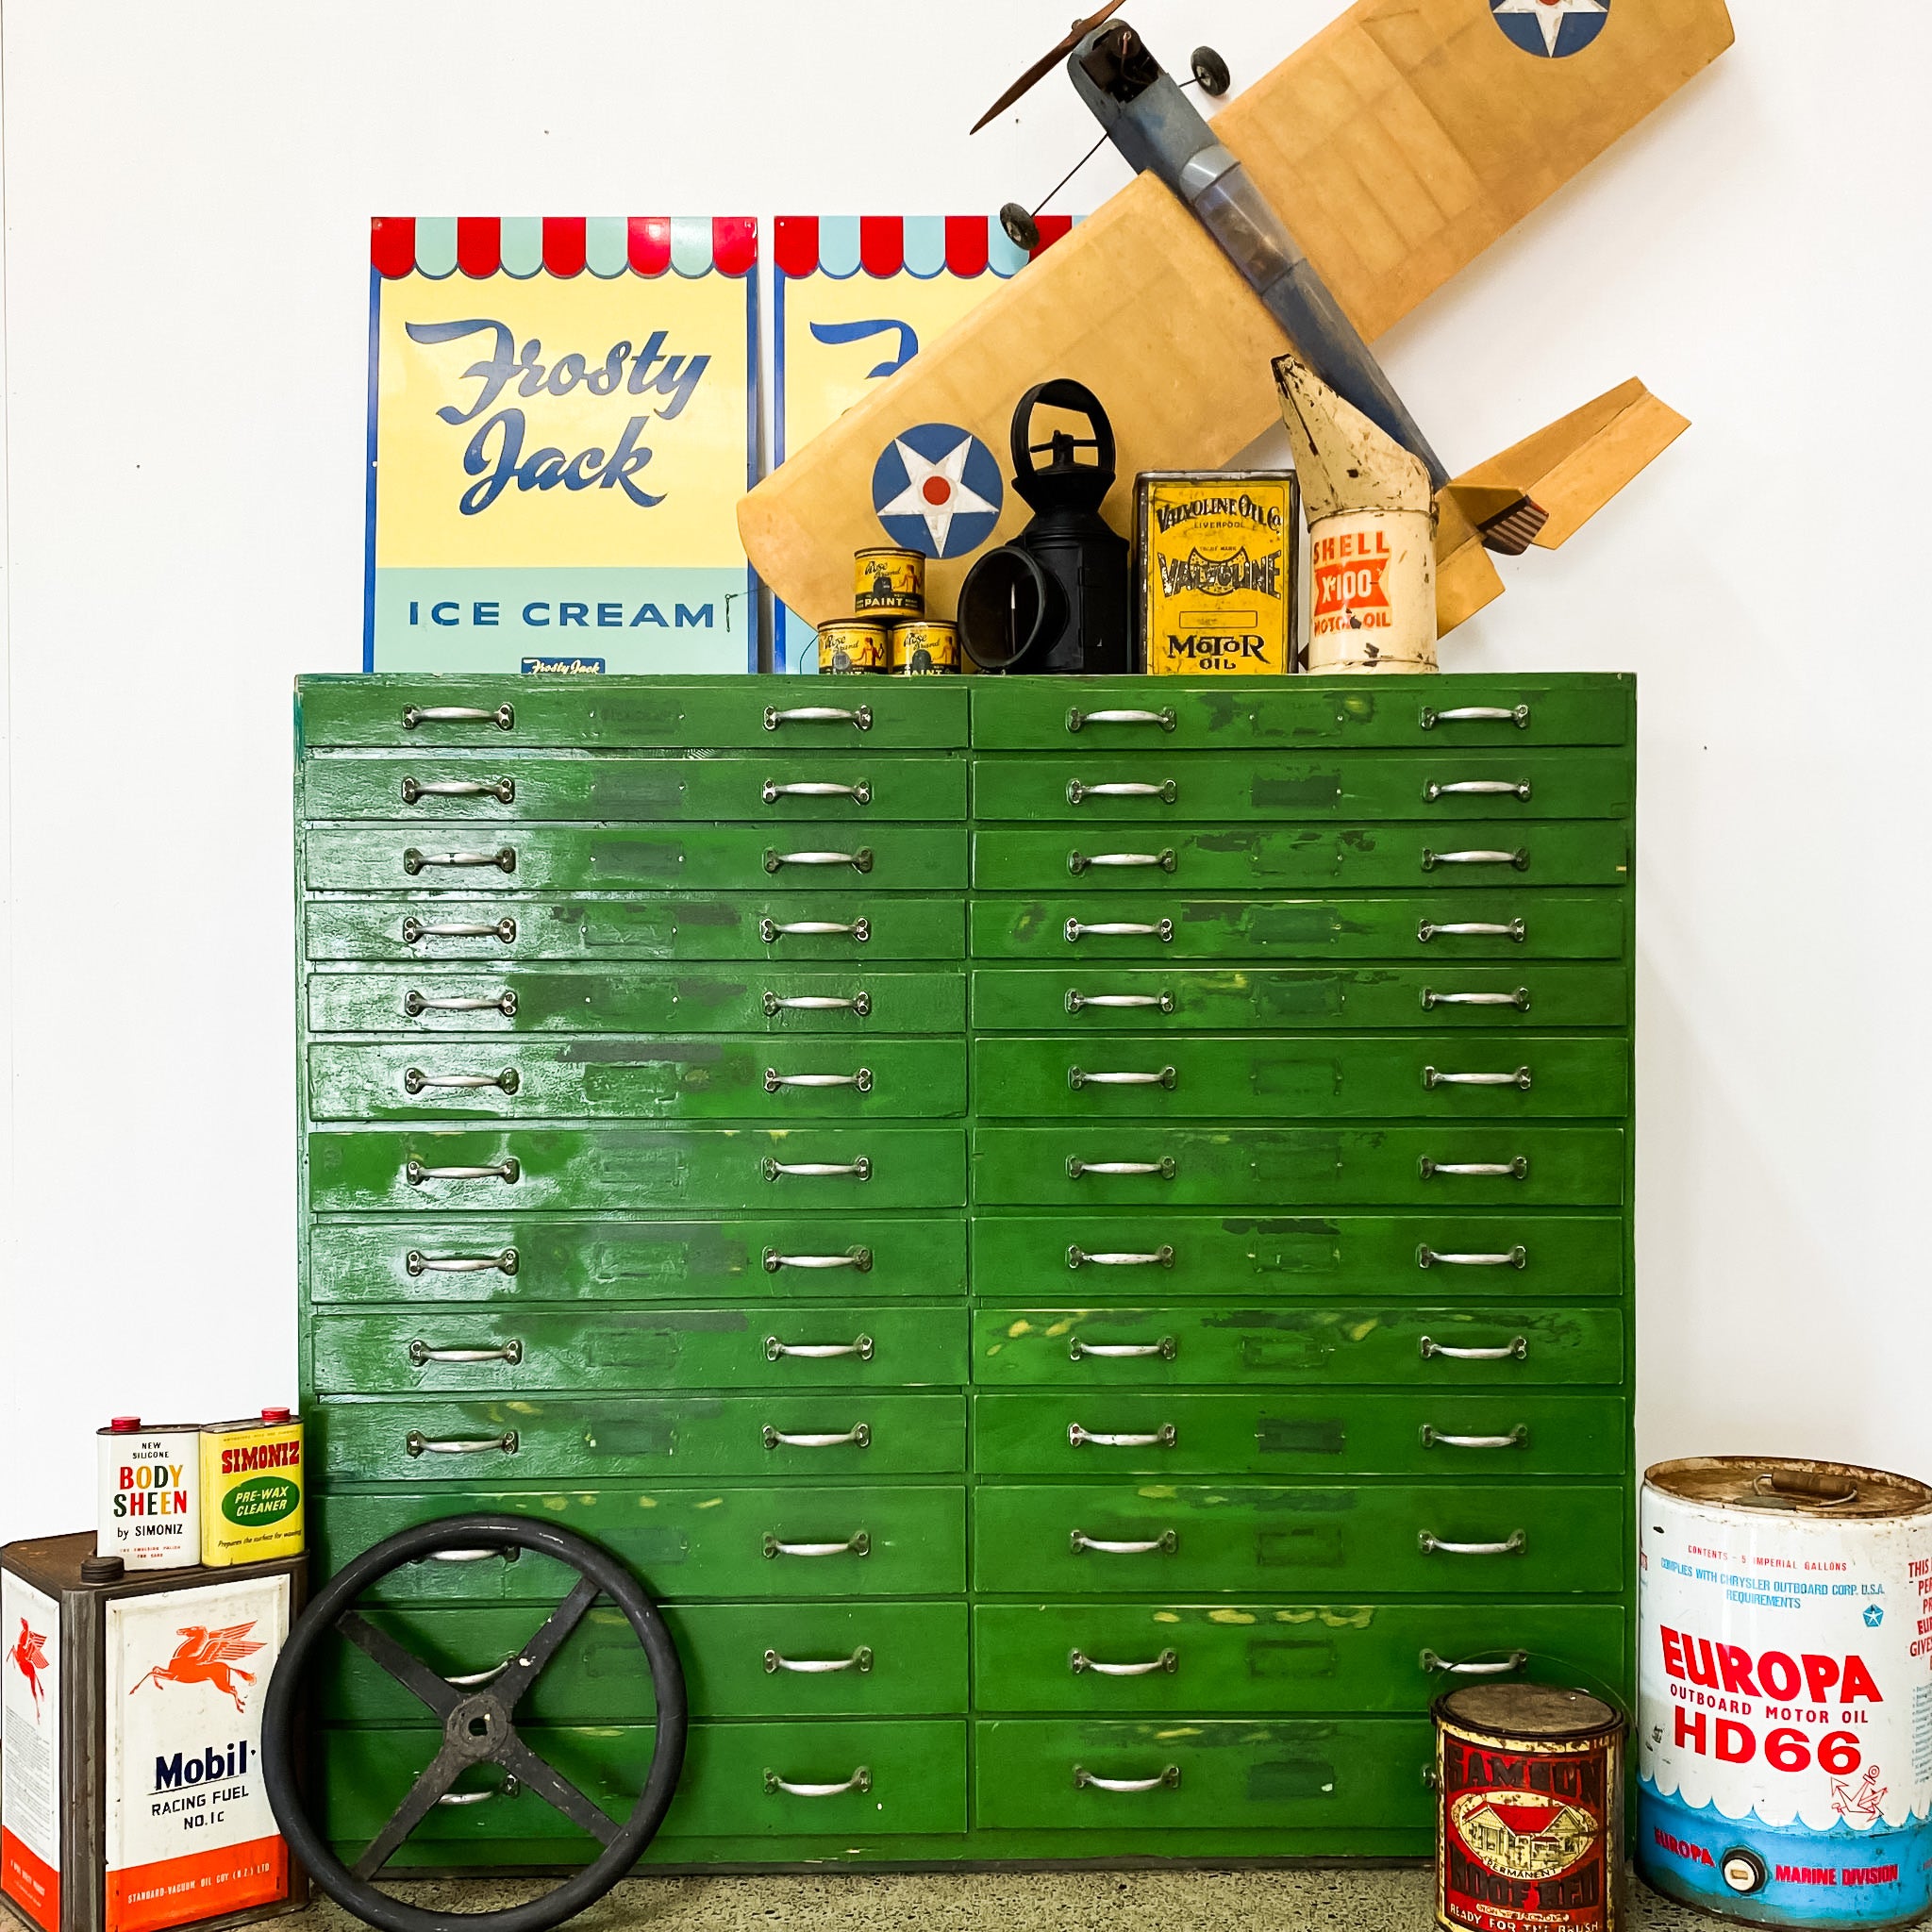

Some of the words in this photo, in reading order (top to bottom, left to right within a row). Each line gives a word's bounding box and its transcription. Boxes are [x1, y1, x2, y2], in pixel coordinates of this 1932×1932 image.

[405, 319, 711, 425] Frosty
[459, 408, 668, 516] Jack
[1157, 498, 1238, 534] VALVOLINE
[1239, 494, 1266, 525] OIL
[1313, 530, 1390, 565] SHELL
[1158, 550, 1282, 600] VALVOLINE
[409, 601, 500, 626] ICE
[522, 602, 714, 628] CREAM
[865, 597, 903, 608] PAINT
[1364, 612, 1391, 629] OIL
[1200, 658, 1236, 670] OIL
[222, 1441, 299, 1474] SIMONIZ
[120, 1464, 183, 1490] BODY
[113, 1491, 187, 1517] SHEEN
[235, 1486, 289, 1504] PRE-WAX
[237, 1500, 287, 1516] CLEANER
[117, 1527, 128, 1541] by
[135, 1524, 182, 1536] SIMONIZ
[218, 1540, 242, 1548] Prepares
[1688, 1545, 1728, 1560] CONTENTS
[1754, 1557, 1797, 1569] IMPERIAL
[1805, 1560, 1846, 1571] GALLONS
[1908, 1558, 1928, 1577] THIS
[1661, 1557, 1692, 1576] COMPLIES
[1696, 1569, 1717, 1583] WITH
[1721, 1574, 1770, 1591] CHRYSLER
[1774, 1581, 1827, 1594] OUTBOARD
[1832, 1585, 1858, 1595] CORP.
[1726, 1590, 1801, 1609] REQUIREMENTS
[1660, 1624, 1883, 1704] EUROPA
[1671, 1684, 1752, 1715] OUTBOARD
[1766, 1706, 1829, 1724] MOTOR
[1841, 1711, 1868, 1724] OIL
[156, 1740, 247, 1790] Mobil
[152, 1794, 206, 1816] RACING
[213, 1786, 249, 1804] FUEL
[1487, 1859, 1557, 1878] PERMANENT
[1655, 1827, 1716, 1868] EUROPA
[1775, 1864, 1837, 1886] MARINE
[1842, 1864, 1898, 1886] DIVISION
[201, 1877, 211, 1888] OIL
[258, 1863, 270, 1874] LTD
[1450, 1904, 1482, 1924] READY
[1490, 1918, 1516, 1932] FOR
